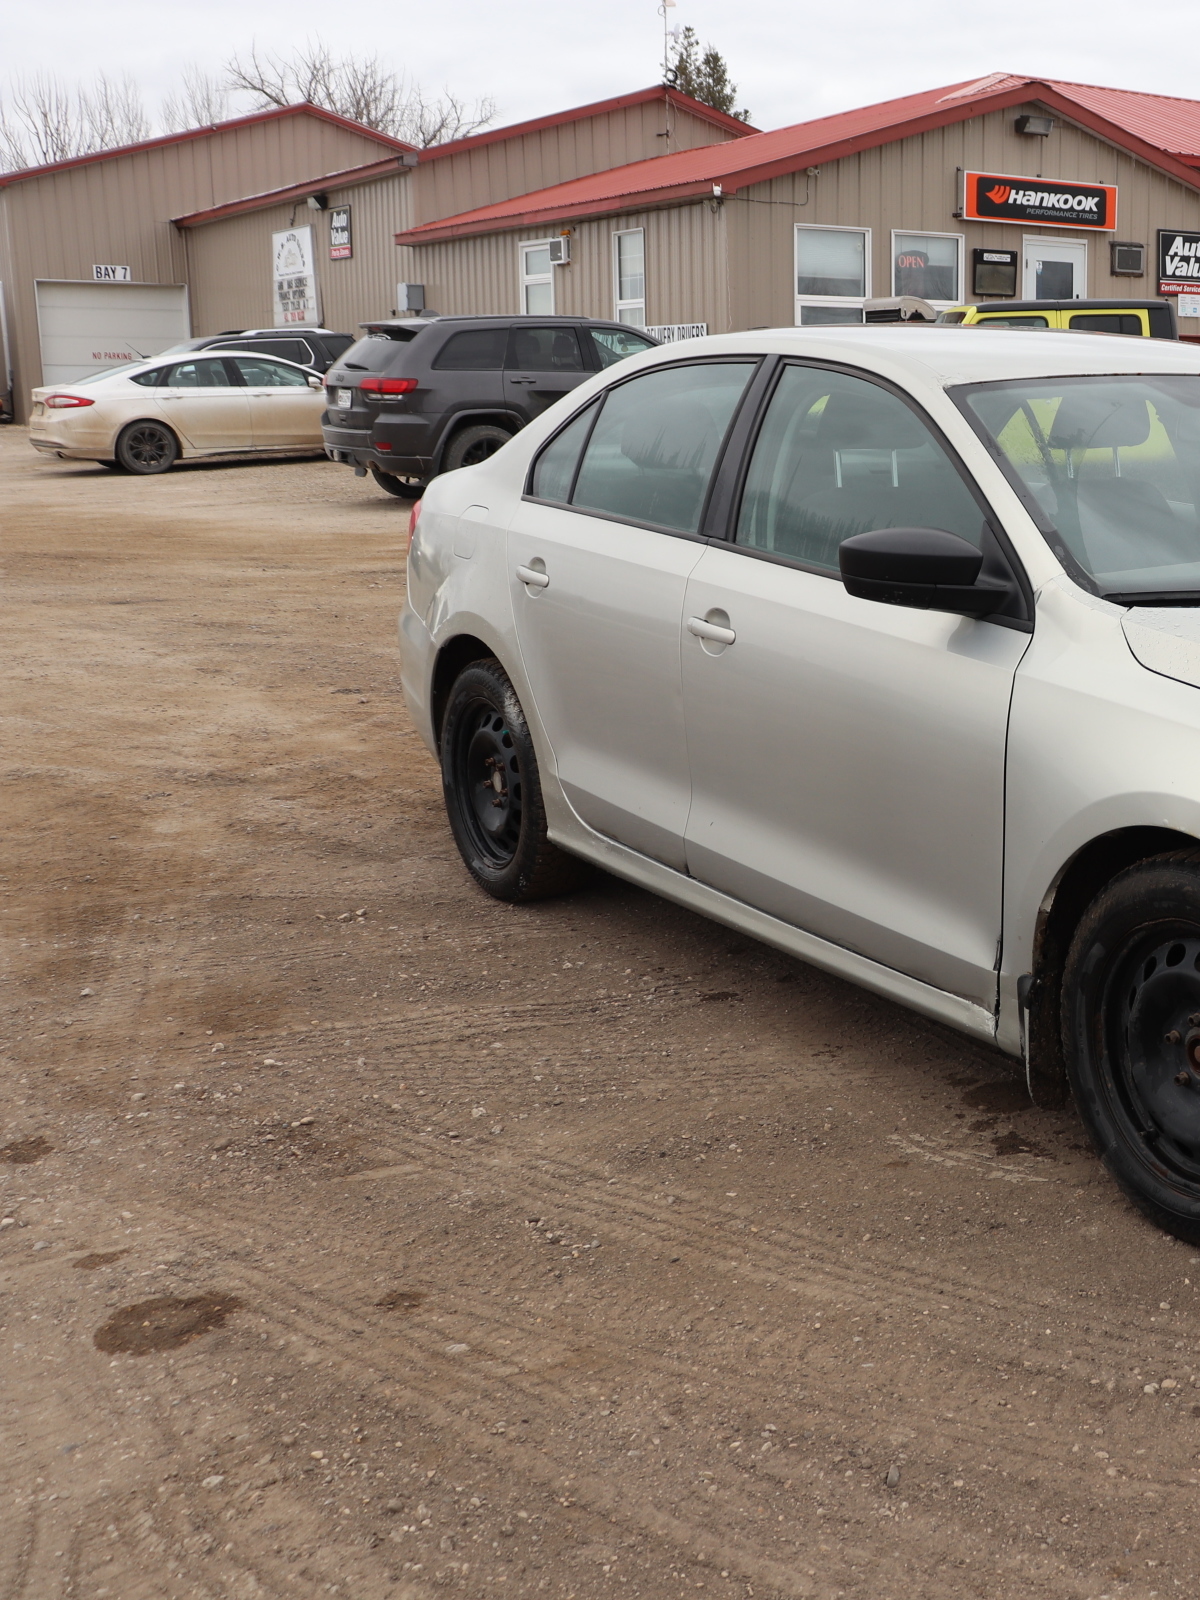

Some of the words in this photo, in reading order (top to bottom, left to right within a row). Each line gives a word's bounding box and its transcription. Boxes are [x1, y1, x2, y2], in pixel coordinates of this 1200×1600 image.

[332, 211, 347, 228] Auto
[1026, 208, 1077, 218] PERFORMANCE
[1078, 212, 1098, 220] TIRES
[330, 228, 349, 245] Value
[898, 255, 925, 268] OPEN
[95, 265, 117, 279] BAY
[121, 266, 128, 280] 7
[1161, 284, 1183, 292] Certified
[677, 325, 704, 341] DRIVERS
[92, 351, 101, 360] NO
[104, 351, 132, 360] PARKING
